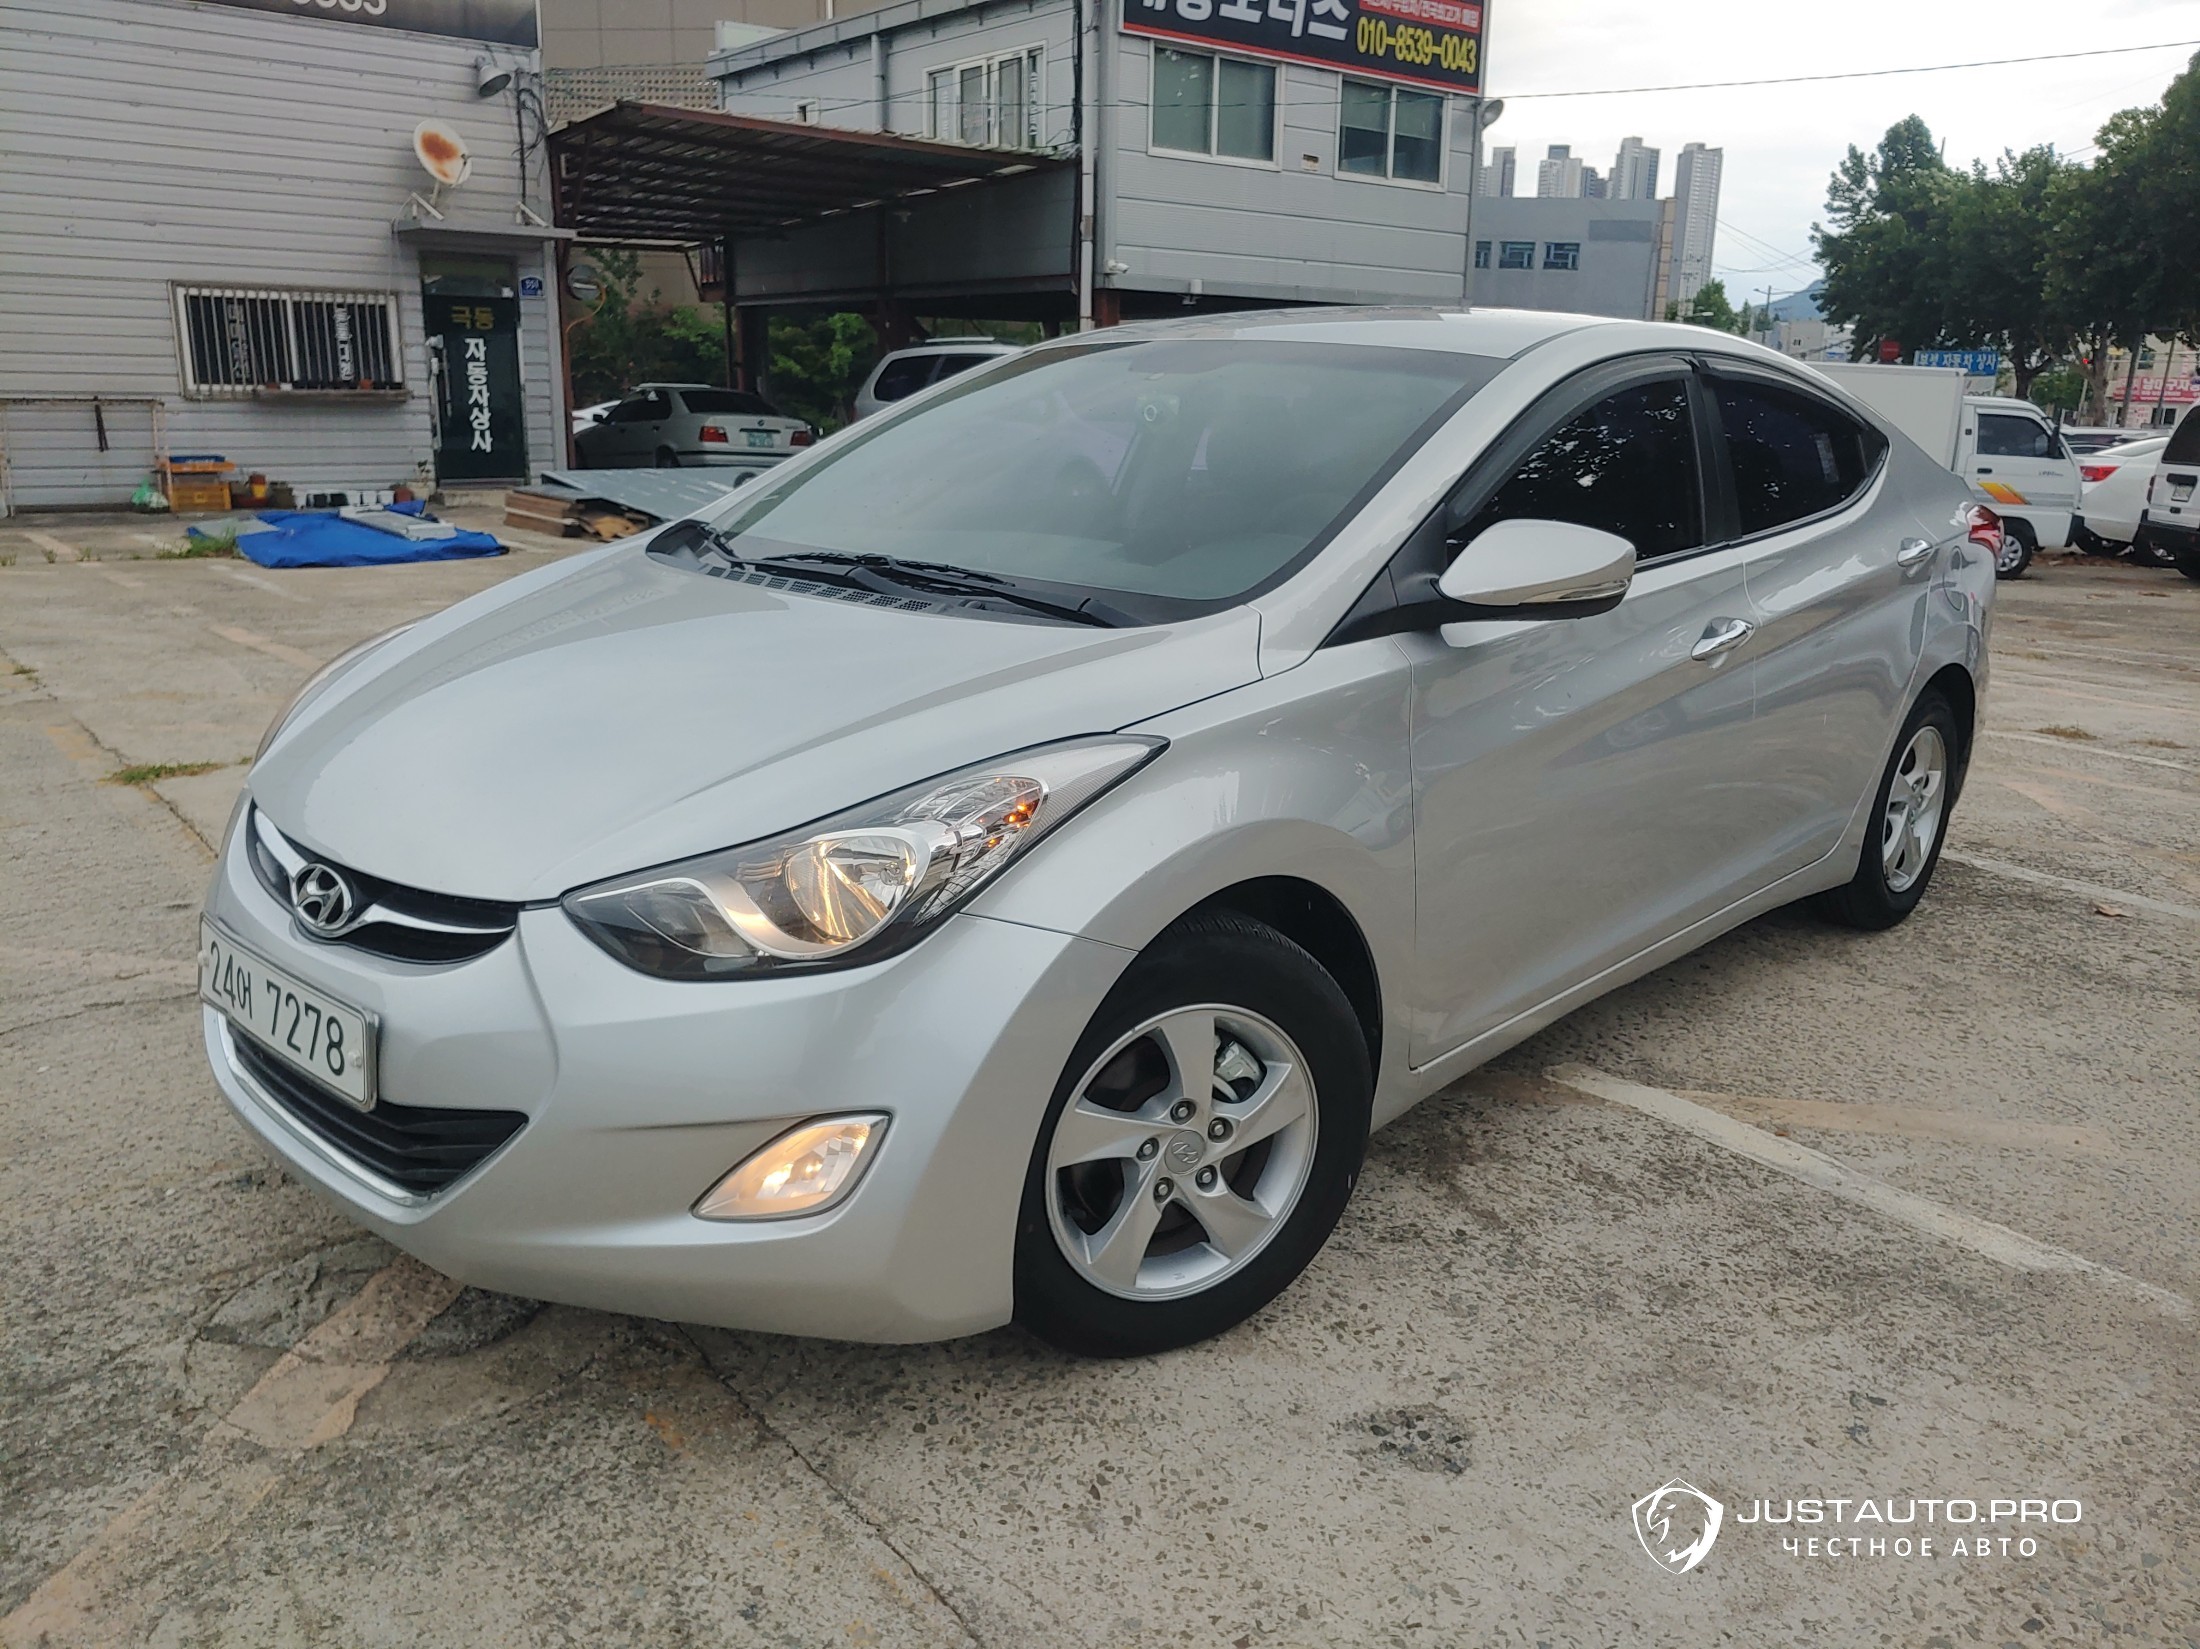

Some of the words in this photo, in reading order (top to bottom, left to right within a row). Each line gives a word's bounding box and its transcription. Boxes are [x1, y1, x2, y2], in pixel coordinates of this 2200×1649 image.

[1357, 16, 1477, 75] 010-8539-0043
[451, 305, 495, 330] 극동
[1977, 353, 1997, 371] 상사
[210, 940, 253, 1020] 24어
[266, 979, 346, 1077] 7278
